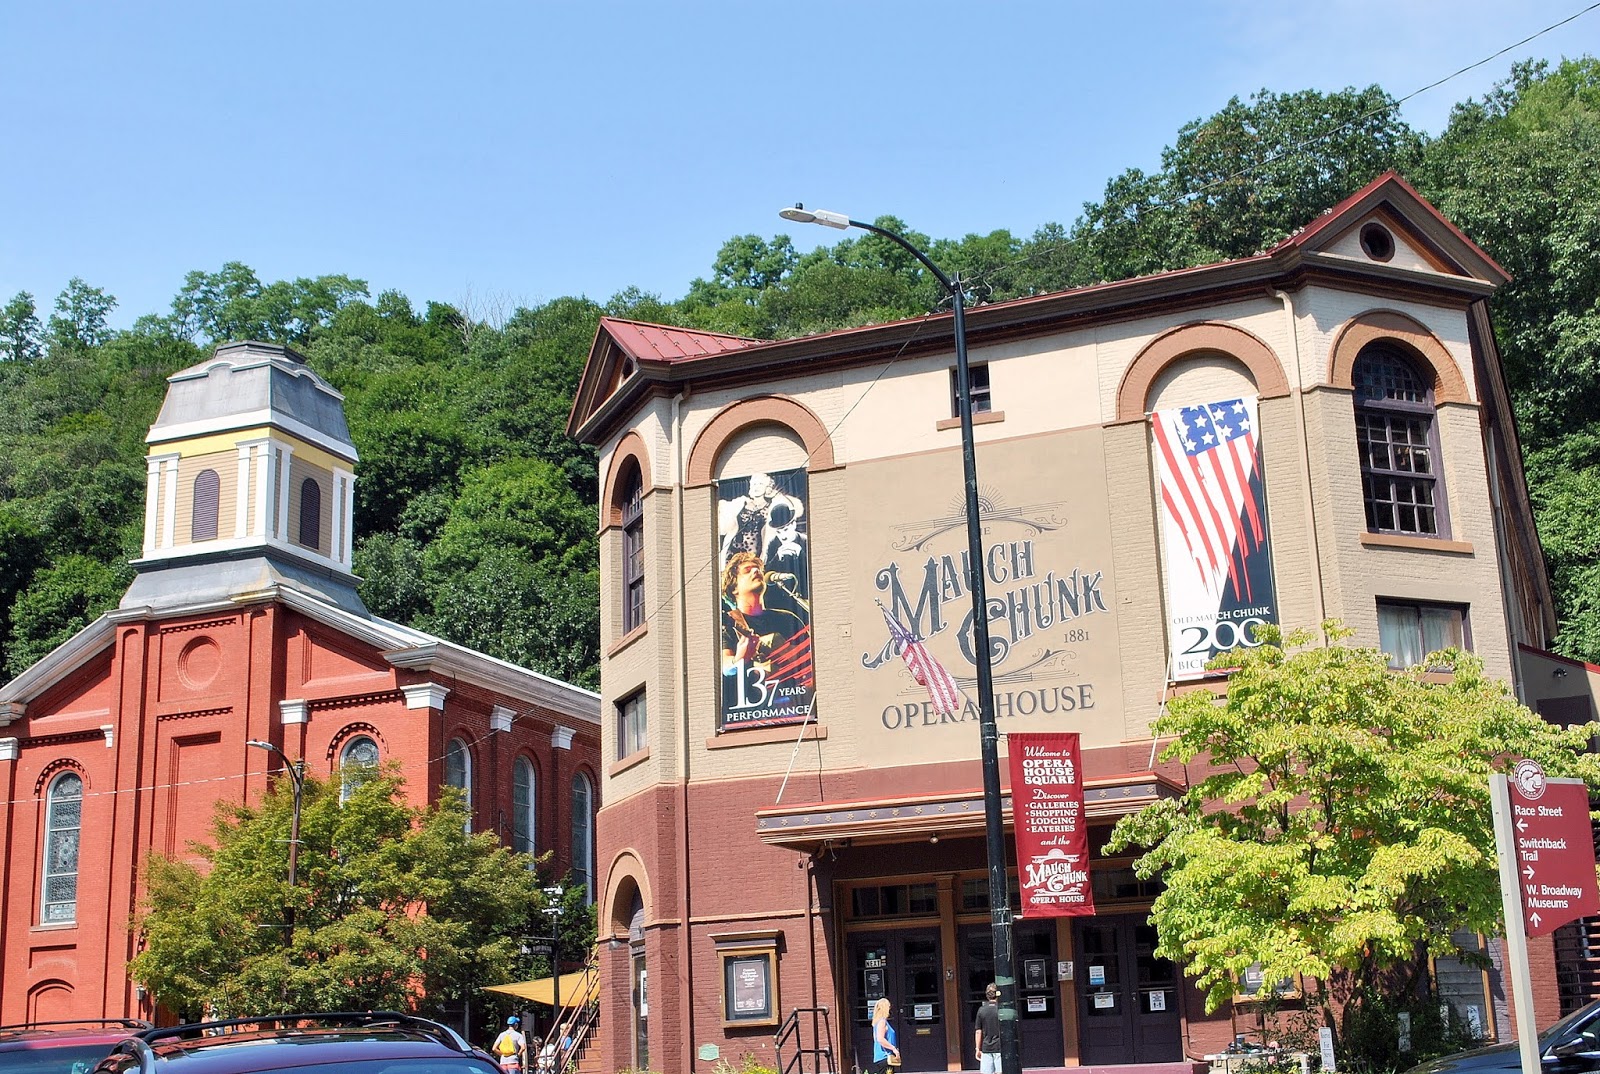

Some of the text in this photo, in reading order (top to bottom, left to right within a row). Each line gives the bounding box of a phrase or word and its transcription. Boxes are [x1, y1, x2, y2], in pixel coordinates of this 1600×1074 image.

[956, 568, 1107, 667] CHUNK
[1173, 606, 1271, 624] OLD MAUCH CHUNK
[1063, 630, 1090, 644] 1881
[729, 658, 806, 710] 137 YEARS
[994, 684, 1096, 718] HOUSE
[726, 704, 811, 722] PERFORMANCE
[1024, 746, 1070, 757] Welcome to
[1022, 759, 1074, 768] OPERA
[1024, 767, 1075, 776] HOUSE
[1025, 776, 1075, 786] SQUARE
[1032, 789, 1069, 800] Discover
[1029, 801, 1079, 809] GALLERIES
[1514, 804, 1563, 817] Race Street
[1029, 809, 1078, 817] SHOPPING
[1030, 817, 1076, 825] LODGING
[1040, 835, 1070, 846] and the
[1519, 837, 1566, 850] Switchback
[1521, 850, 1539, 862] Trail
[1023, 861, 1071, 888] MAUCH
[1047, 870, 1088, 892] CHUNK
[1526, 884, 1582, 899] W. Broadway
[1030, 895, 1085, 904] OPERA HOUSE
[1528, 897, 1569, 908] Museums
